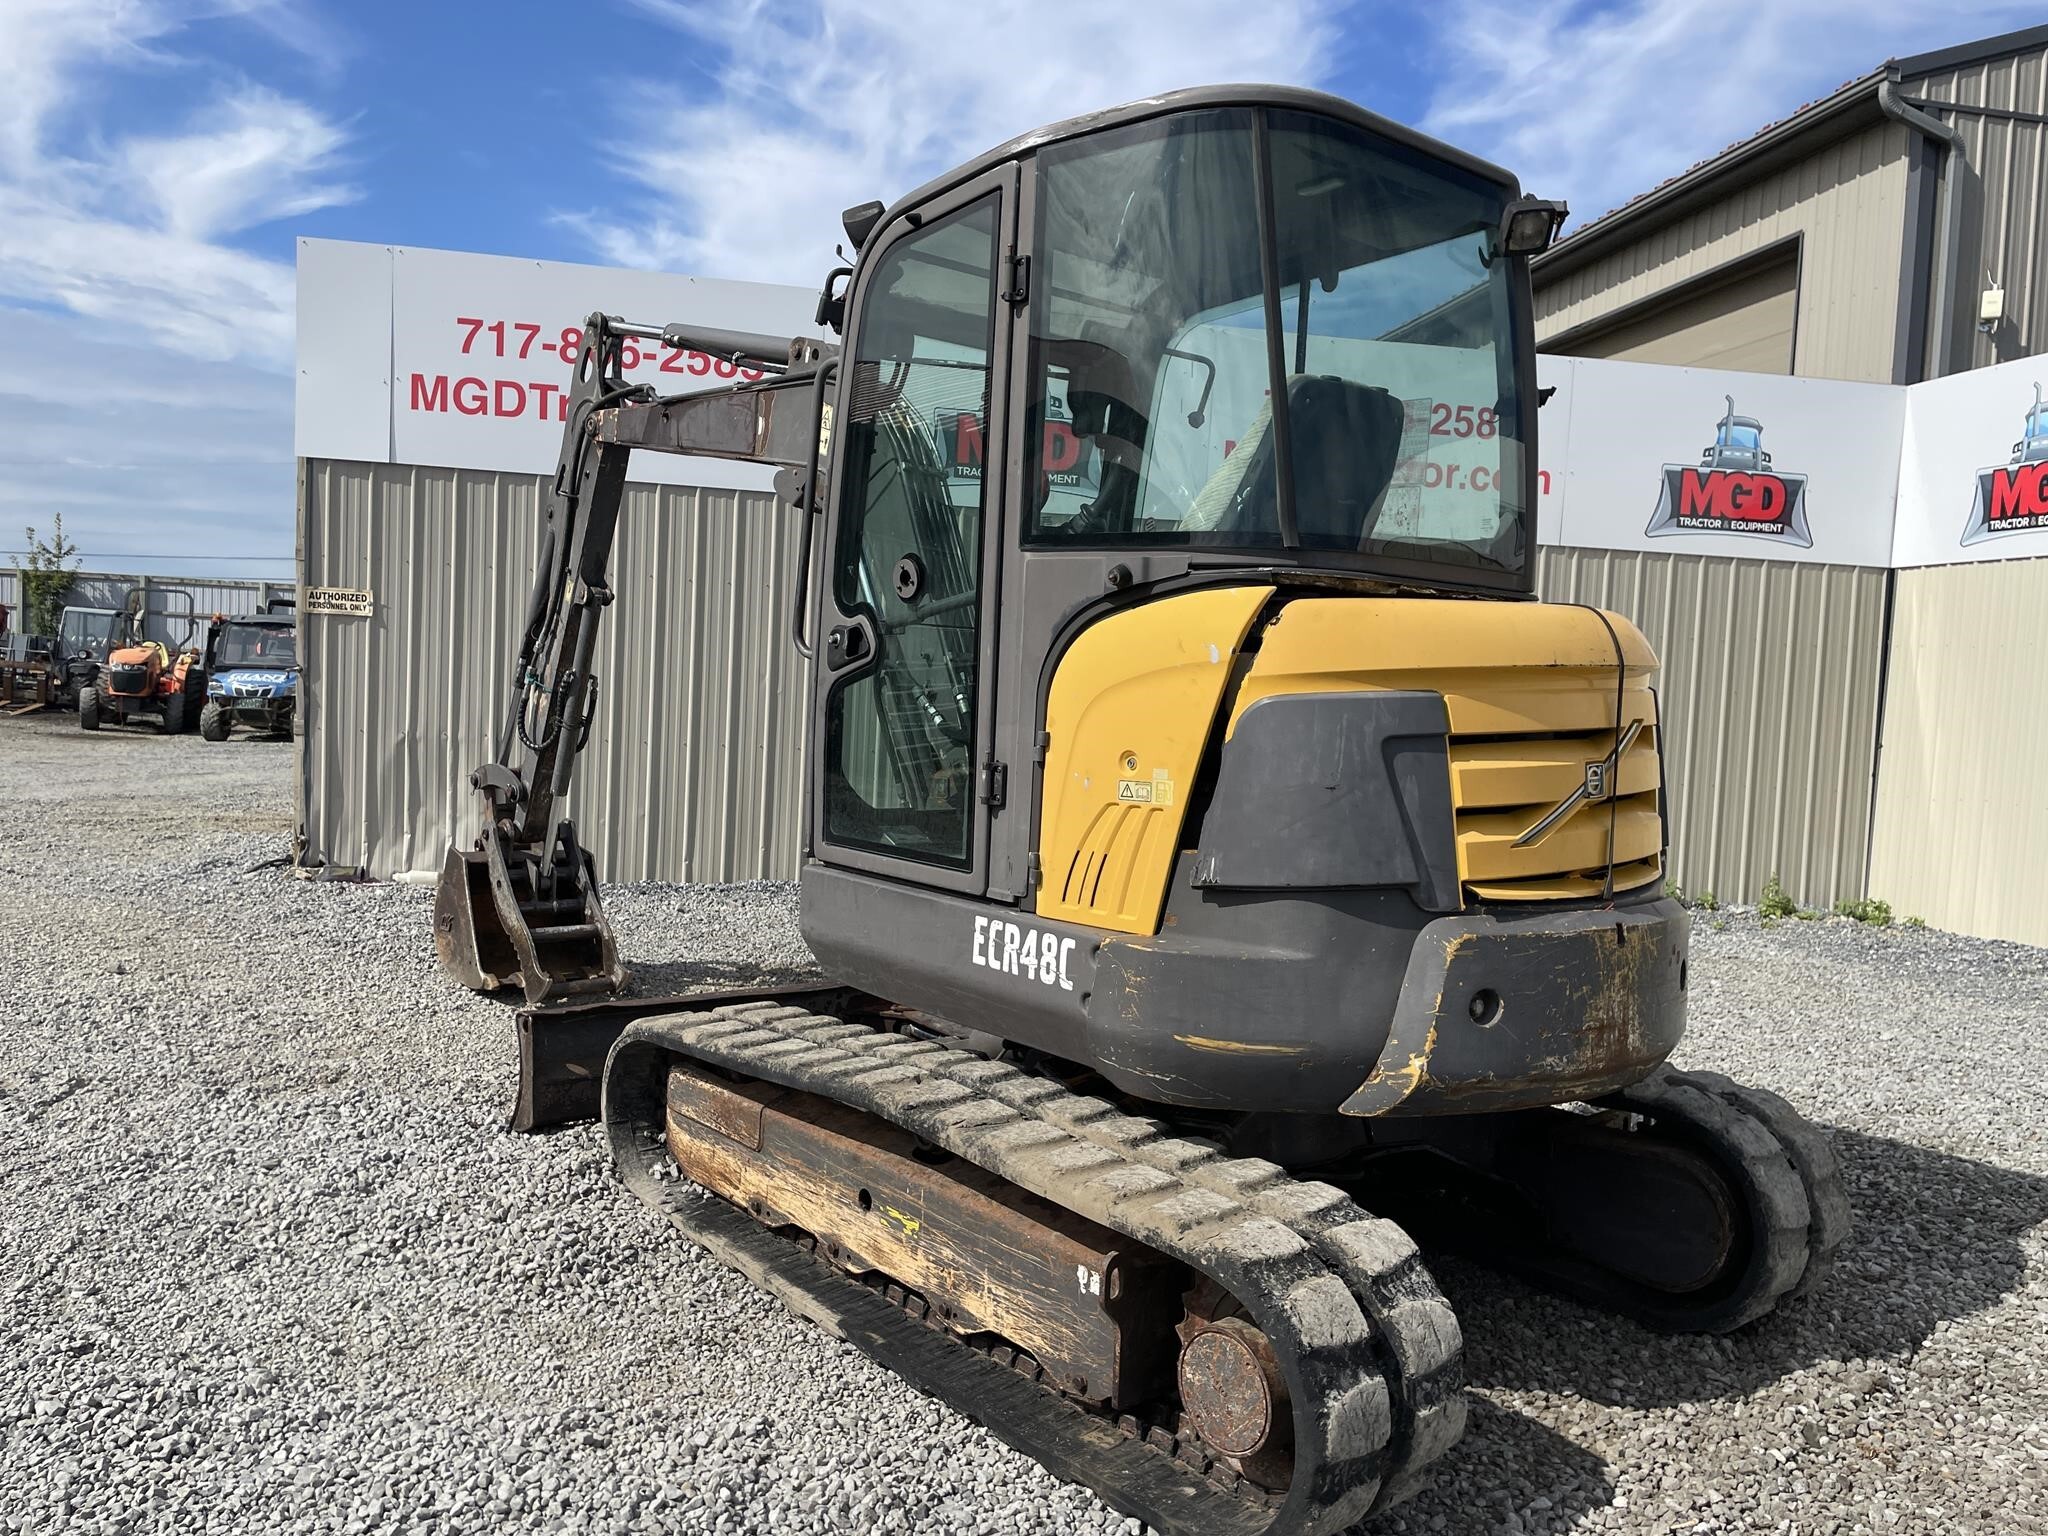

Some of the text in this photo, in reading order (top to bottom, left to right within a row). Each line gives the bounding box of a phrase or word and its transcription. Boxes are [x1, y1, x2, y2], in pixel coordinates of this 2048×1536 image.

[1680, 469, 1786, 521] MGD
[1990, 461, 2048, 519] MG
[1679, 517, 1721, 529] TRACTOR
[1731, 521, 1783, 533] EQUIPMENT
[1990, 518, 2029, 530] TRACTOR
[308, 591, 368, 603] AUTHORIZED
[308, 601, 367, 612] PERSONNEL ONLY
[972, 915, 1076, 991] ECR48C
